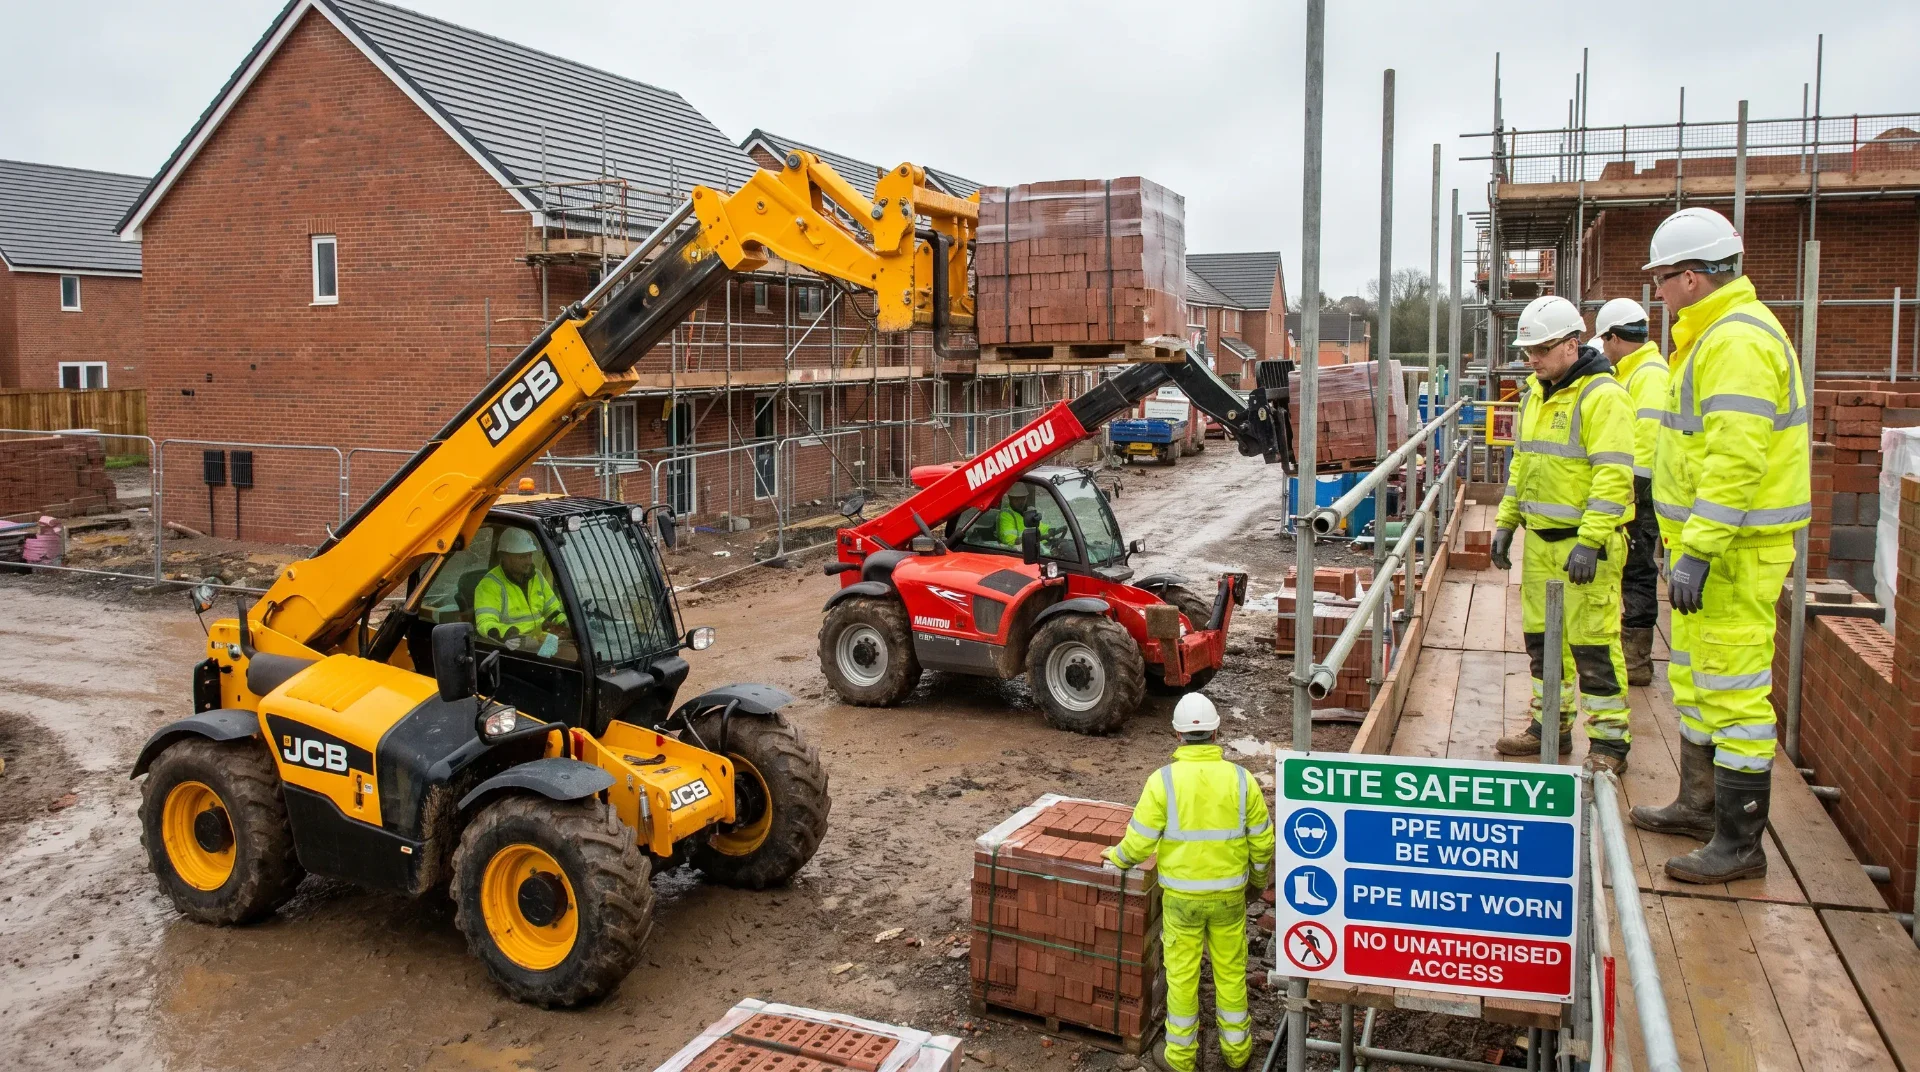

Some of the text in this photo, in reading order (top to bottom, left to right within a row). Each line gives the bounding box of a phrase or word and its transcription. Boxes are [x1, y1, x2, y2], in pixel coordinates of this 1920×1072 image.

[488, 360, 558, 441] JCB
[965, 419, 1055, 491] MANITOU
[914, 615, 950, 629] MANITOU
[283, 737, 348, 772] JCB
[671, 780, 709, 810] JCB
[1301, 766, 1555, 809] SITE SAFETY:
[1391, 817, 1524, 845] PPE MUST
[1395, 843, 1519, 870] BE WORN
[1353, 884, 1562, 919] PPE MIST WORN
[1353, 931, 1562, 966] NO UNATHORISED
[1408, 959, 1504, 983] ACCESS
